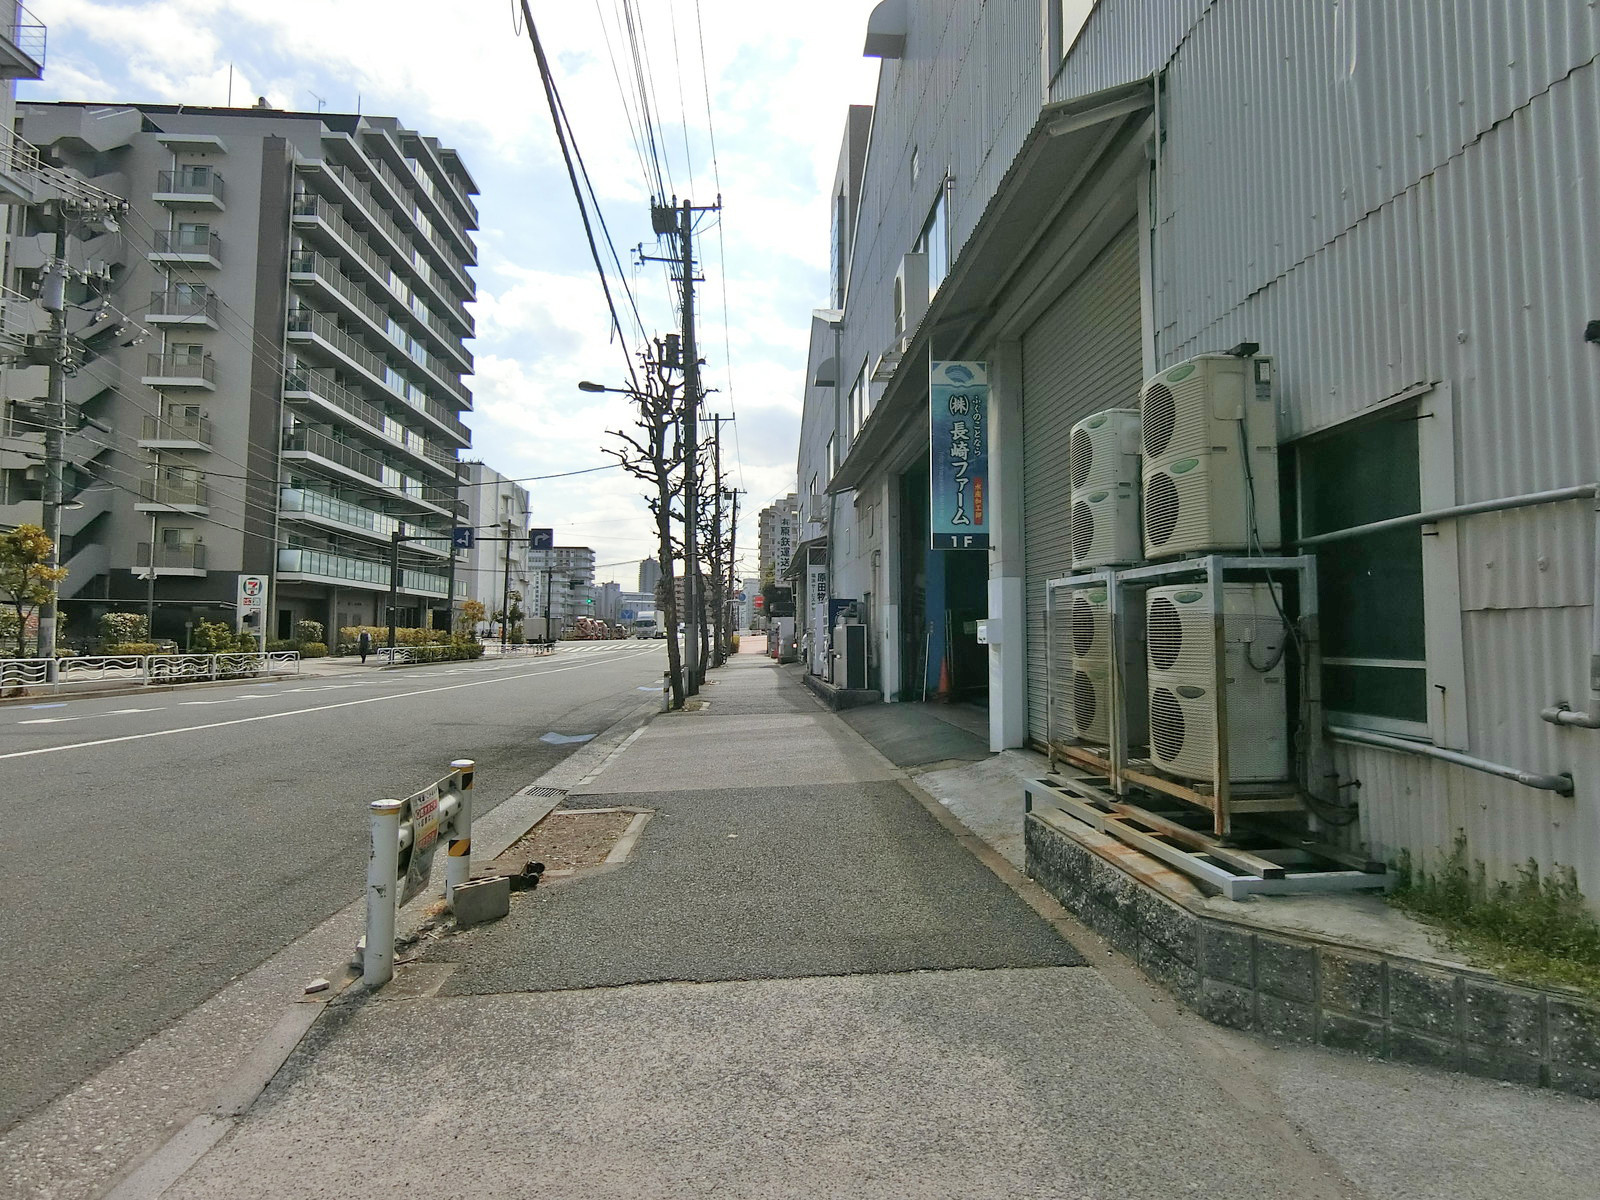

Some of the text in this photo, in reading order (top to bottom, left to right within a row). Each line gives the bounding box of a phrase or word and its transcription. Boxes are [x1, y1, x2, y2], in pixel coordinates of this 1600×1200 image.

[951, 535, 973, 548] 1F
[817, 572, 826, 603] 原田物
